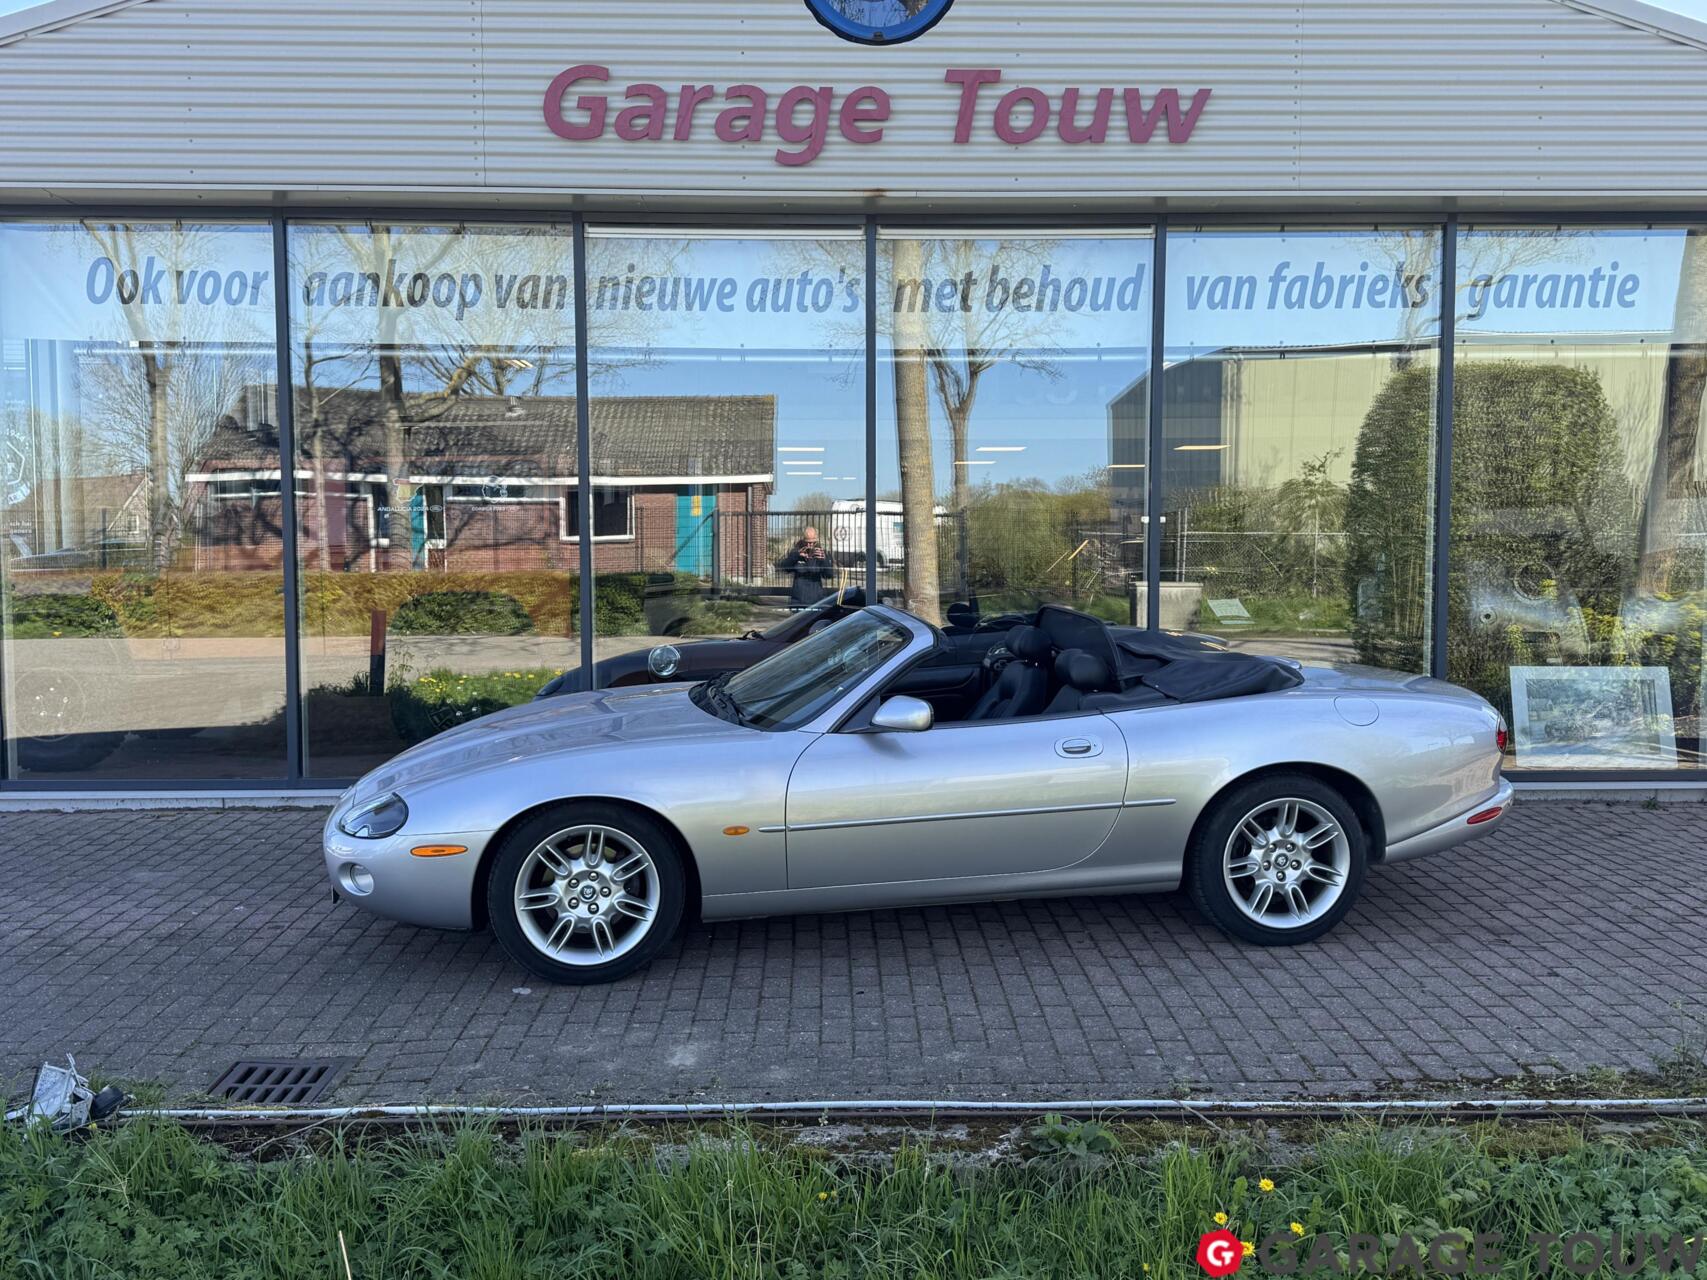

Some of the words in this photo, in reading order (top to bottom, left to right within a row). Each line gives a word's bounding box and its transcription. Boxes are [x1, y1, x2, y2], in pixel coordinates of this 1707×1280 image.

[544, 64, 892, 167] Garage
[945, 69, 1213, 144] Touw
[86, 256, 165, 306] Ook
[175, 269, 269, 306] voor
[303, 259, 483, 321] aankoop
[495, 272, 568, 309] van
[595, 264, 738, 312] nieuwe
[752, 265, 862, 313] auto's
[893, 270, 979, 312] met
[984, 263, 1147, 312] behoud
[1186, 274, 1258, 311] van
[1267, 260, 1432, 311] fabrieks
[1467, 263, 1640, 319] garantie
